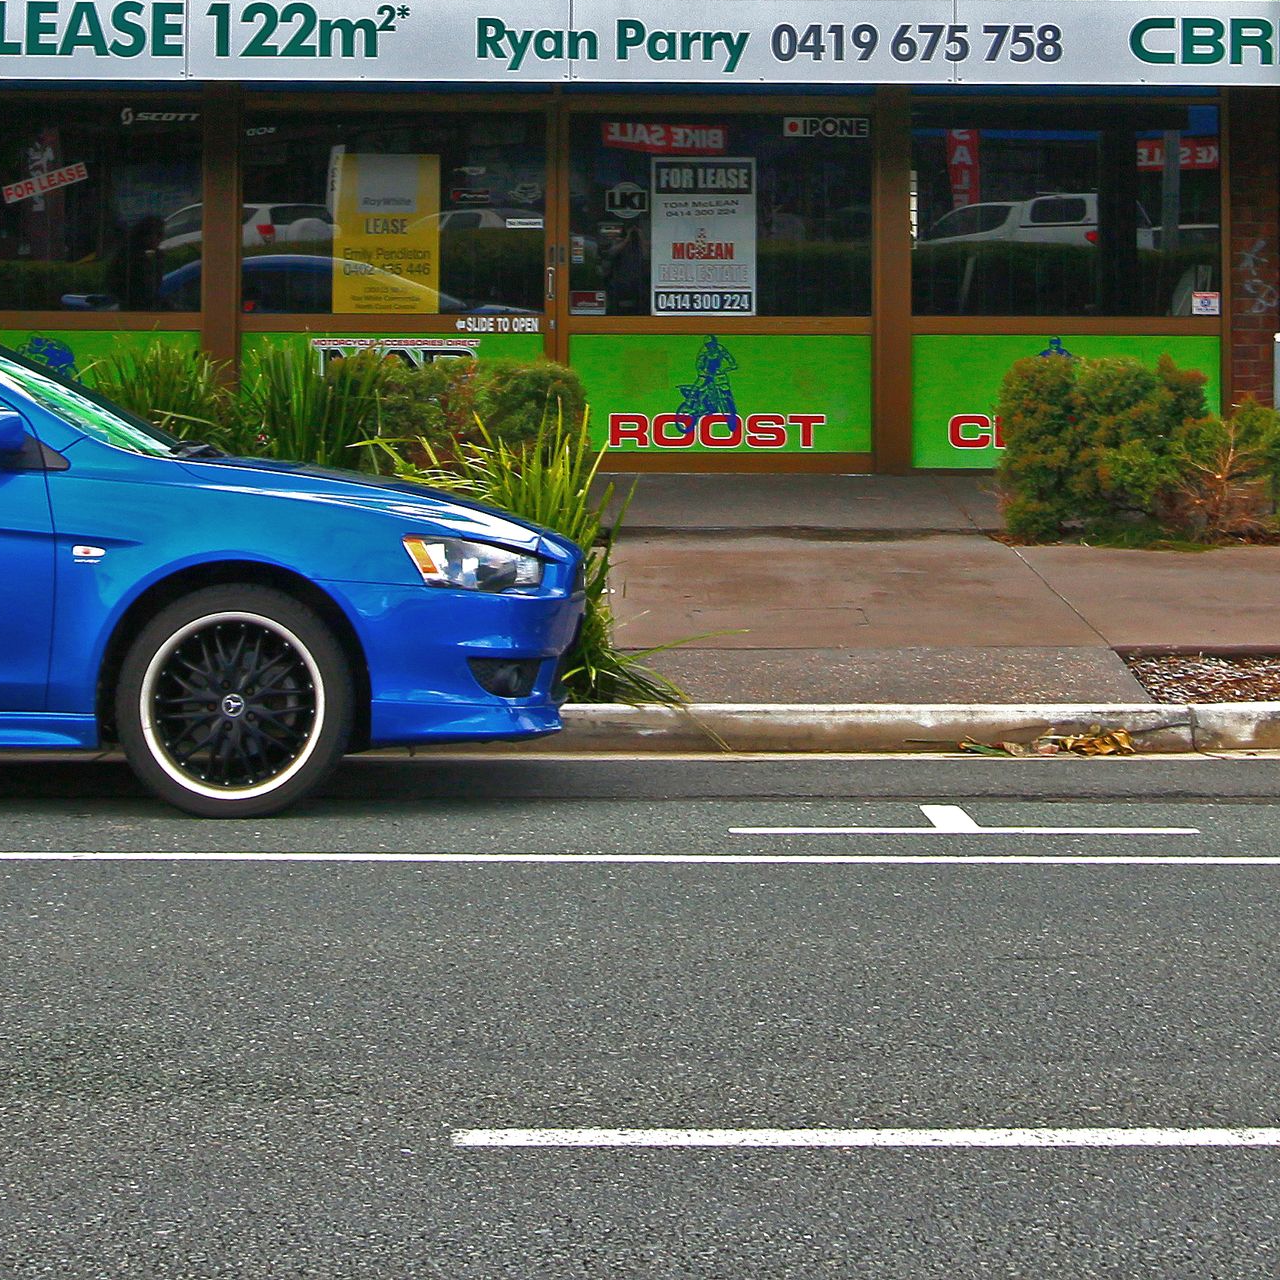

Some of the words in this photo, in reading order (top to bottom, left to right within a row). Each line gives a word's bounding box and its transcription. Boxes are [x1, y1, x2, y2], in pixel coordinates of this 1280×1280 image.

[476, 18, 599, 71] Ryan
[616, 18, 751, 72] Parry
[770, 23, 878, 64] 0419
[889, 23, 970, 64] 675
[982, 23, 1063, 64] 758
[136, 112, 201, 121] SCOTT
[4, 181, 35, 201] FOR
[38, 163, 88, 191] LEASE
[658, 167, 694, 189] FOR
[697, 167, 750, 189] LEASE
[663, 201, 689, 209] TOM
[365, 218, 409, 235] LEASE
[343, 247, 372, 263] Emily
[657, 293, 691, 311] 0414
[692, 293, 721, 311] 300
[723, 293, 750, 311] 224
[466, 317, 494, 332] SLIDE
[496, 317, 511, 332] TO
[511, 317, 539, 333] OPEN
[446, 339, 480, 347] DIRECT
[608, 412, 826, 449] ROOST
